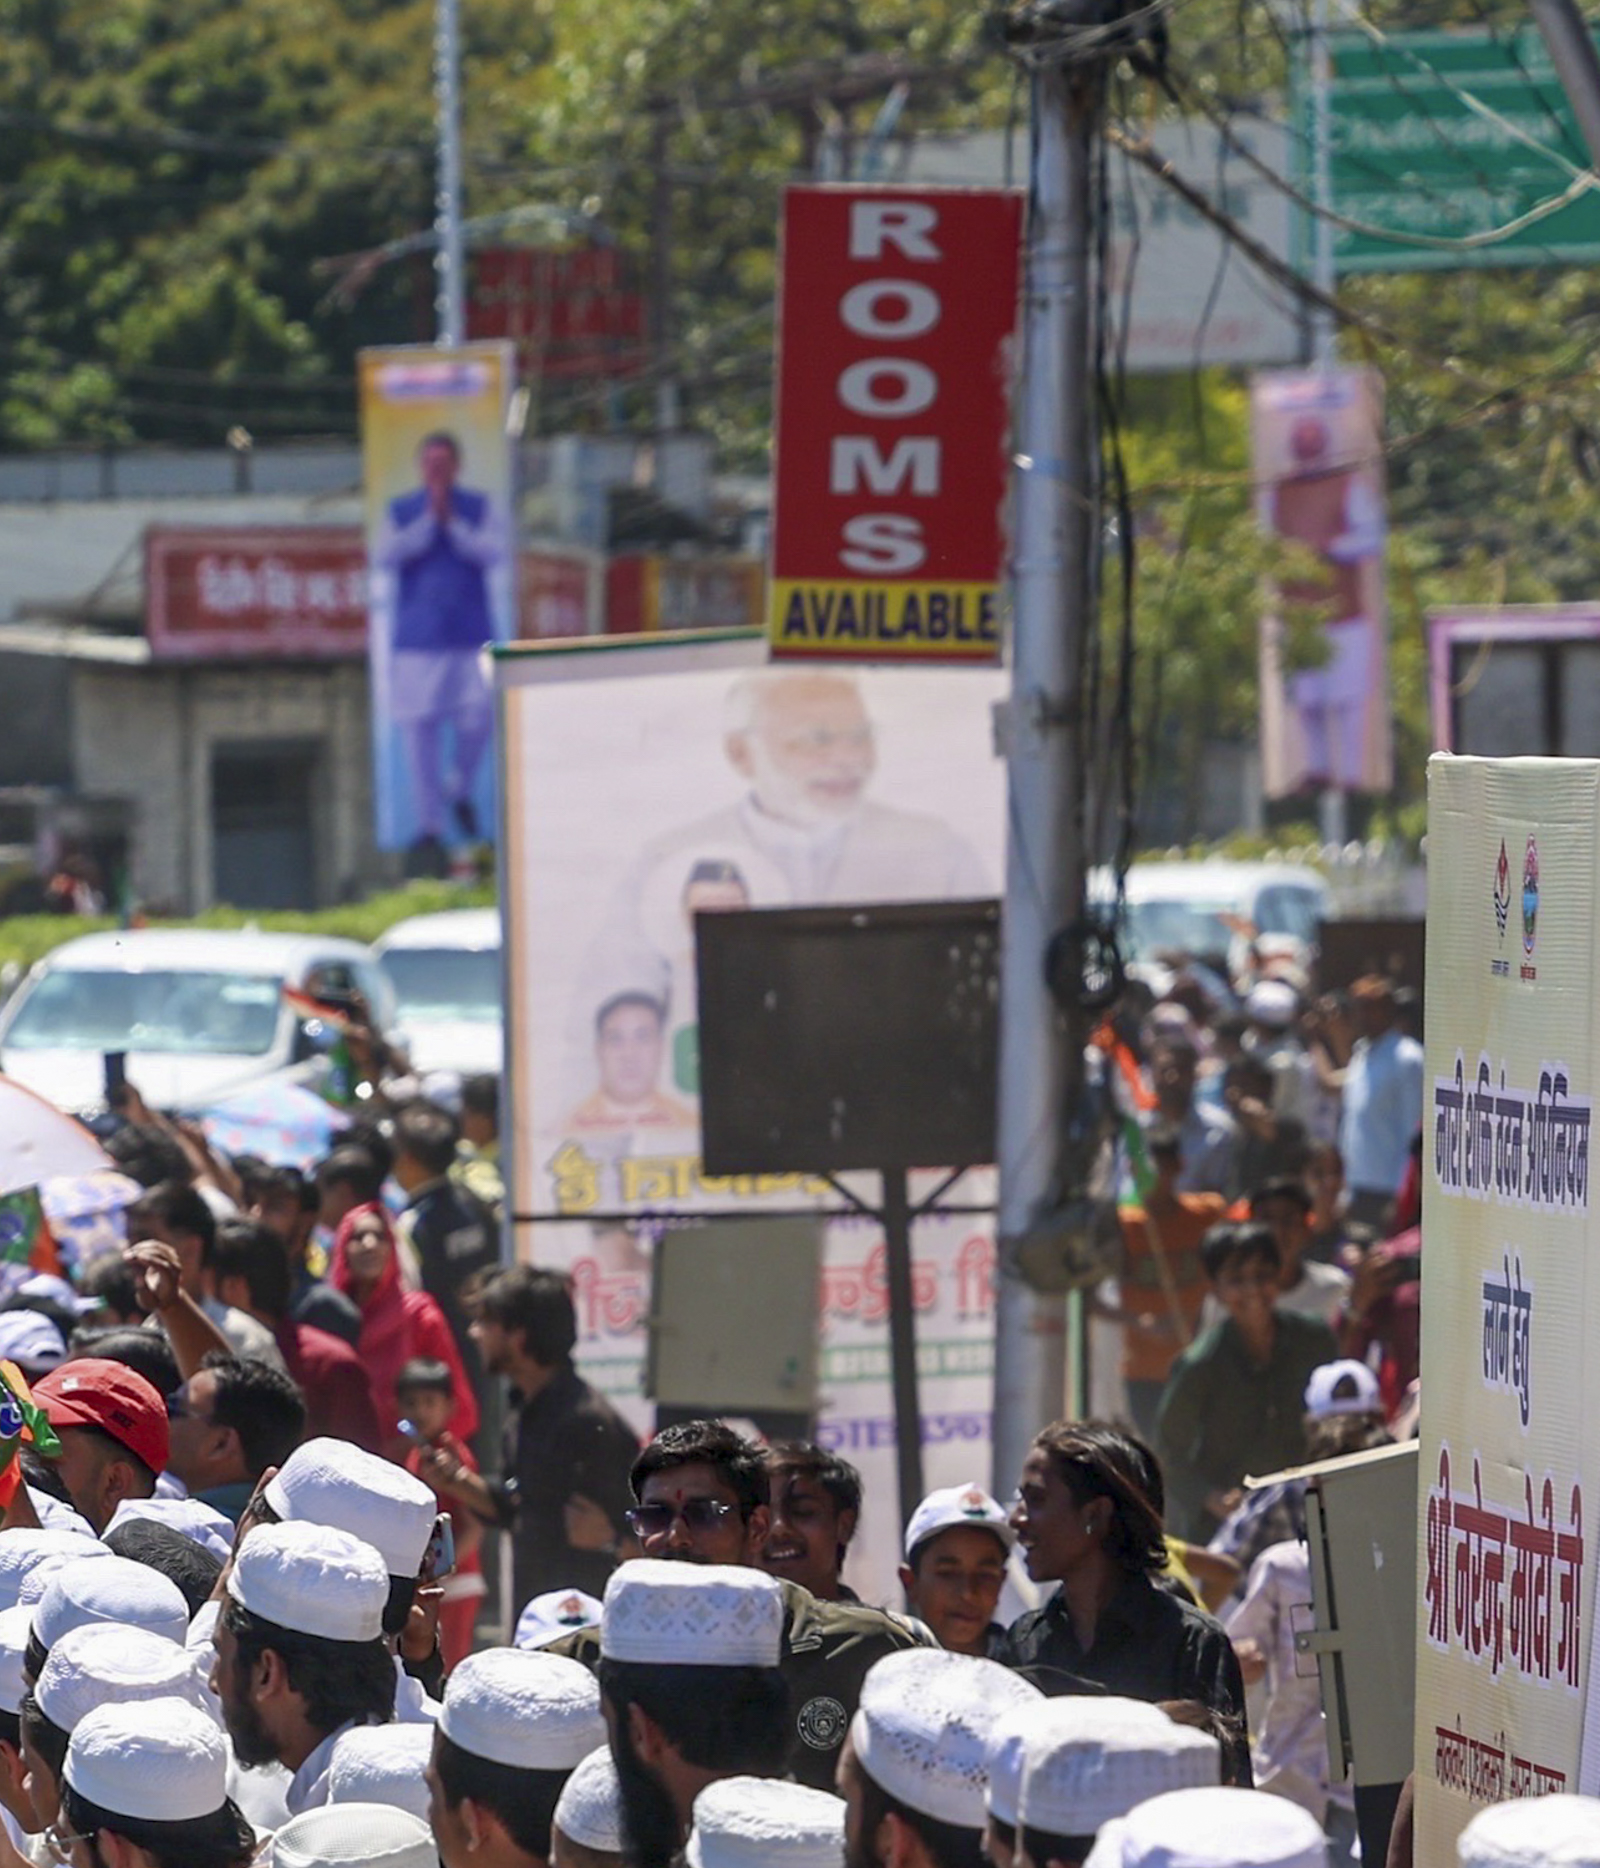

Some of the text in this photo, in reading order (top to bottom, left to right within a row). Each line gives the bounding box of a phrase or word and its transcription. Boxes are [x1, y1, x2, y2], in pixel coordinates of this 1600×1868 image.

[830, 201, 941, 575] ROOMS
[784, 587, 998, 642] AVAILABLE
[1435, 1058, 1591, 1207] नारी शक्ति वंदन अधिनियम
[1483, 1255, 1532, 1427] लाने हेतु
[1426, 1449, 1584, 1688] श्री नरेन्द्र मोदी जी
